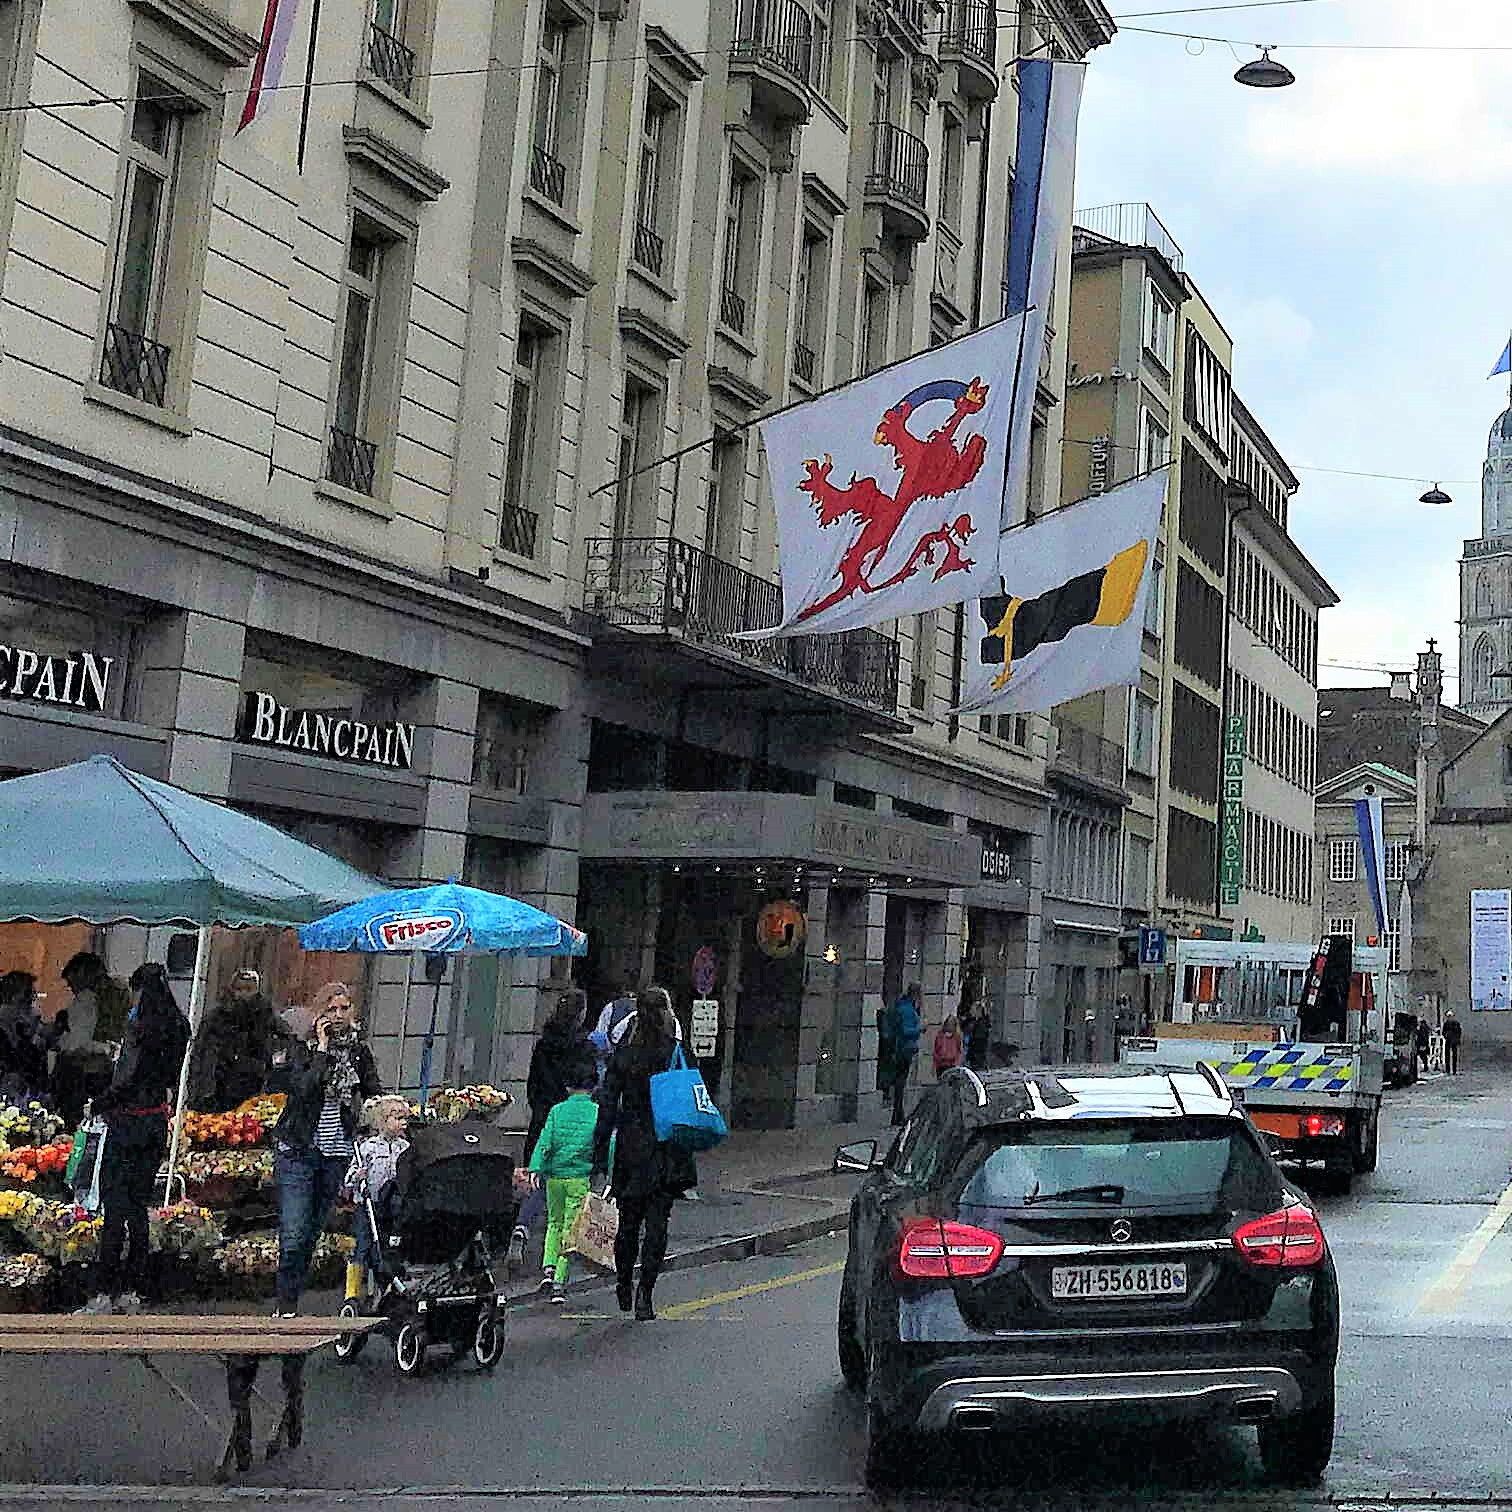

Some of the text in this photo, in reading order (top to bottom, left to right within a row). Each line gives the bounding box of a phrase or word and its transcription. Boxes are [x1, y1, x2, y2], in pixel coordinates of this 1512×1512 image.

[252, 691, 417, 769] BLANCPAIN
[1224, 717, 1242, 903] PHARMACIE
[383, 920, 452, 945] Frisco
